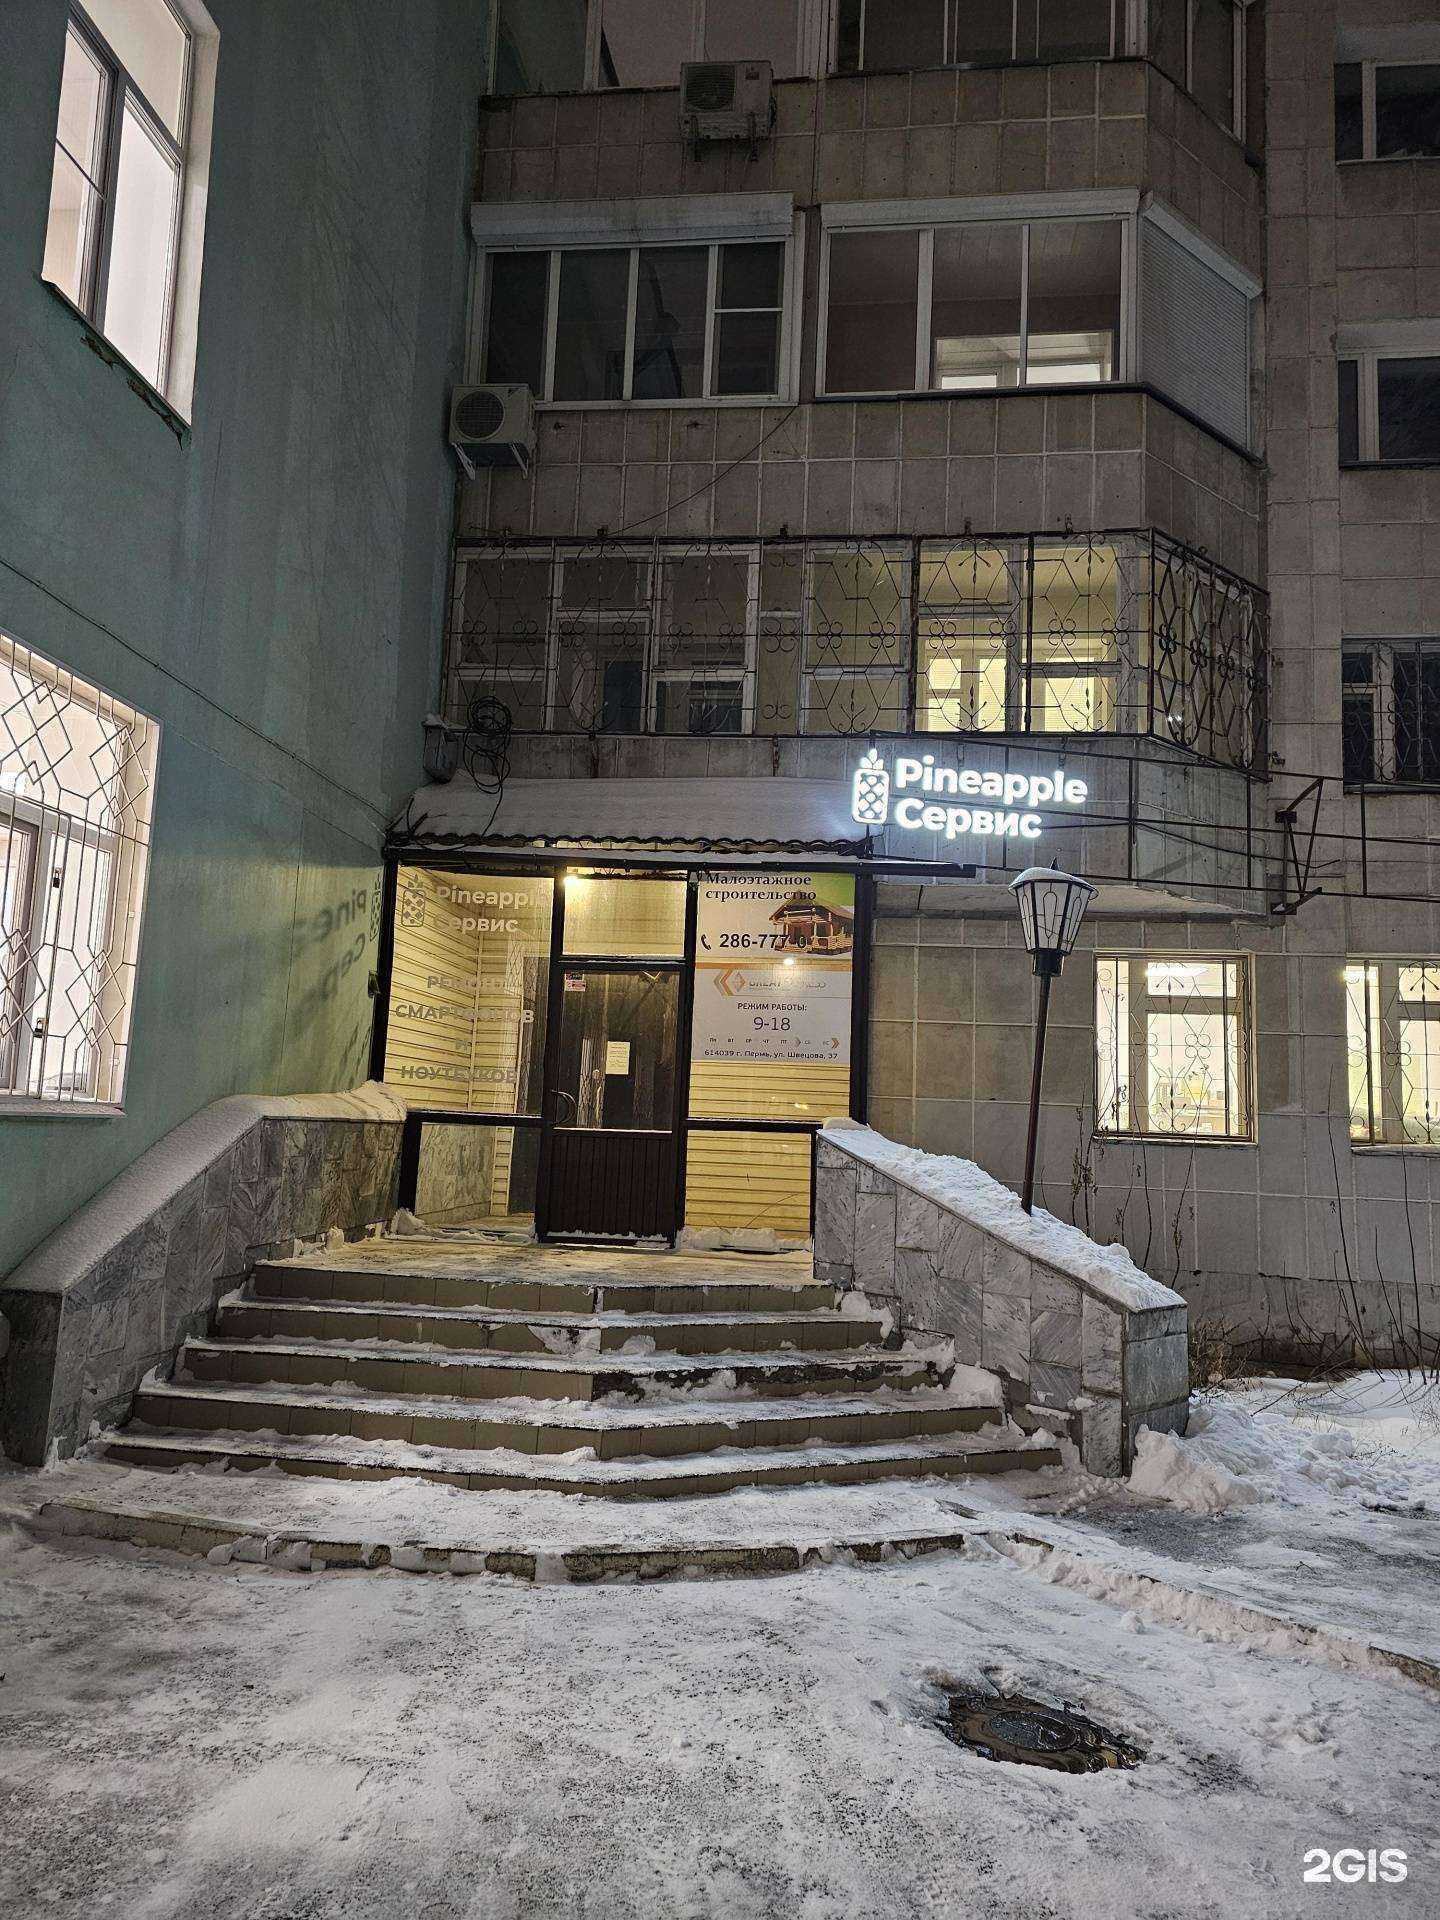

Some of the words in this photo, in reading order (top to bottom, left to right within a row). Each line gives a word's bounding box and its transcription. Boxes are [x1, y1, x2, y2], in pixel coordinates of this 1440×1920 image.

[896, 755, 1088, 807] Pineapple
[895, 798, 1043, 840] Сервис
[706, 872, 812, 886] Малоэтажное
[705, 889, 817, 903] строительство
[719, 933, 808, 949] 286-7770
[737, 1002, 769, 1011] РЕЖИМ
[771, 1003, 808, 1012] РАБОТЫ:
[753, 1016, 791, 1032] 9-18
